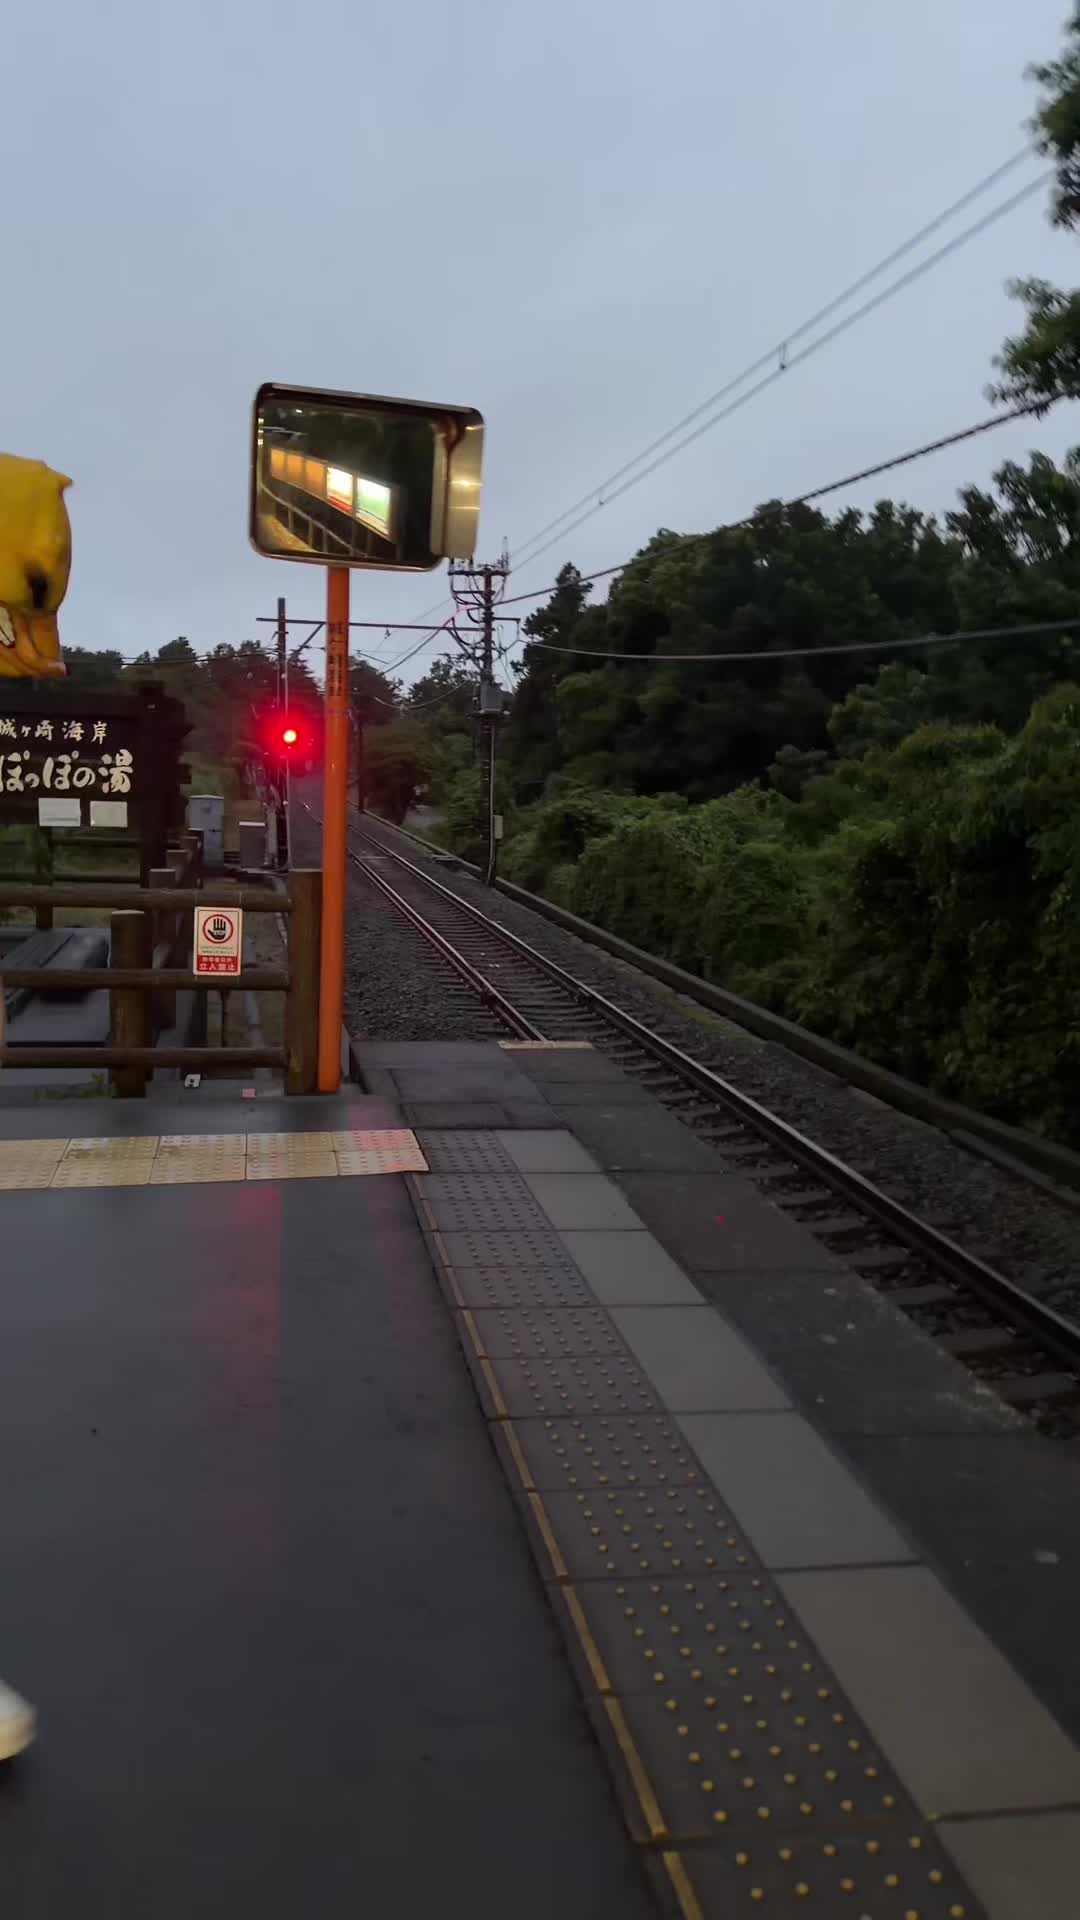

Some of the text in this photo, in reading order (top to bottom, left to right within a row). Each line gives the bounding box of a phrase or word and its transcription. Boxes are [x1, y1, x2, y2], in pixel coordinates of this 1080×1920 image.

[0, 748, 133, 794] ぽっぽの湯
